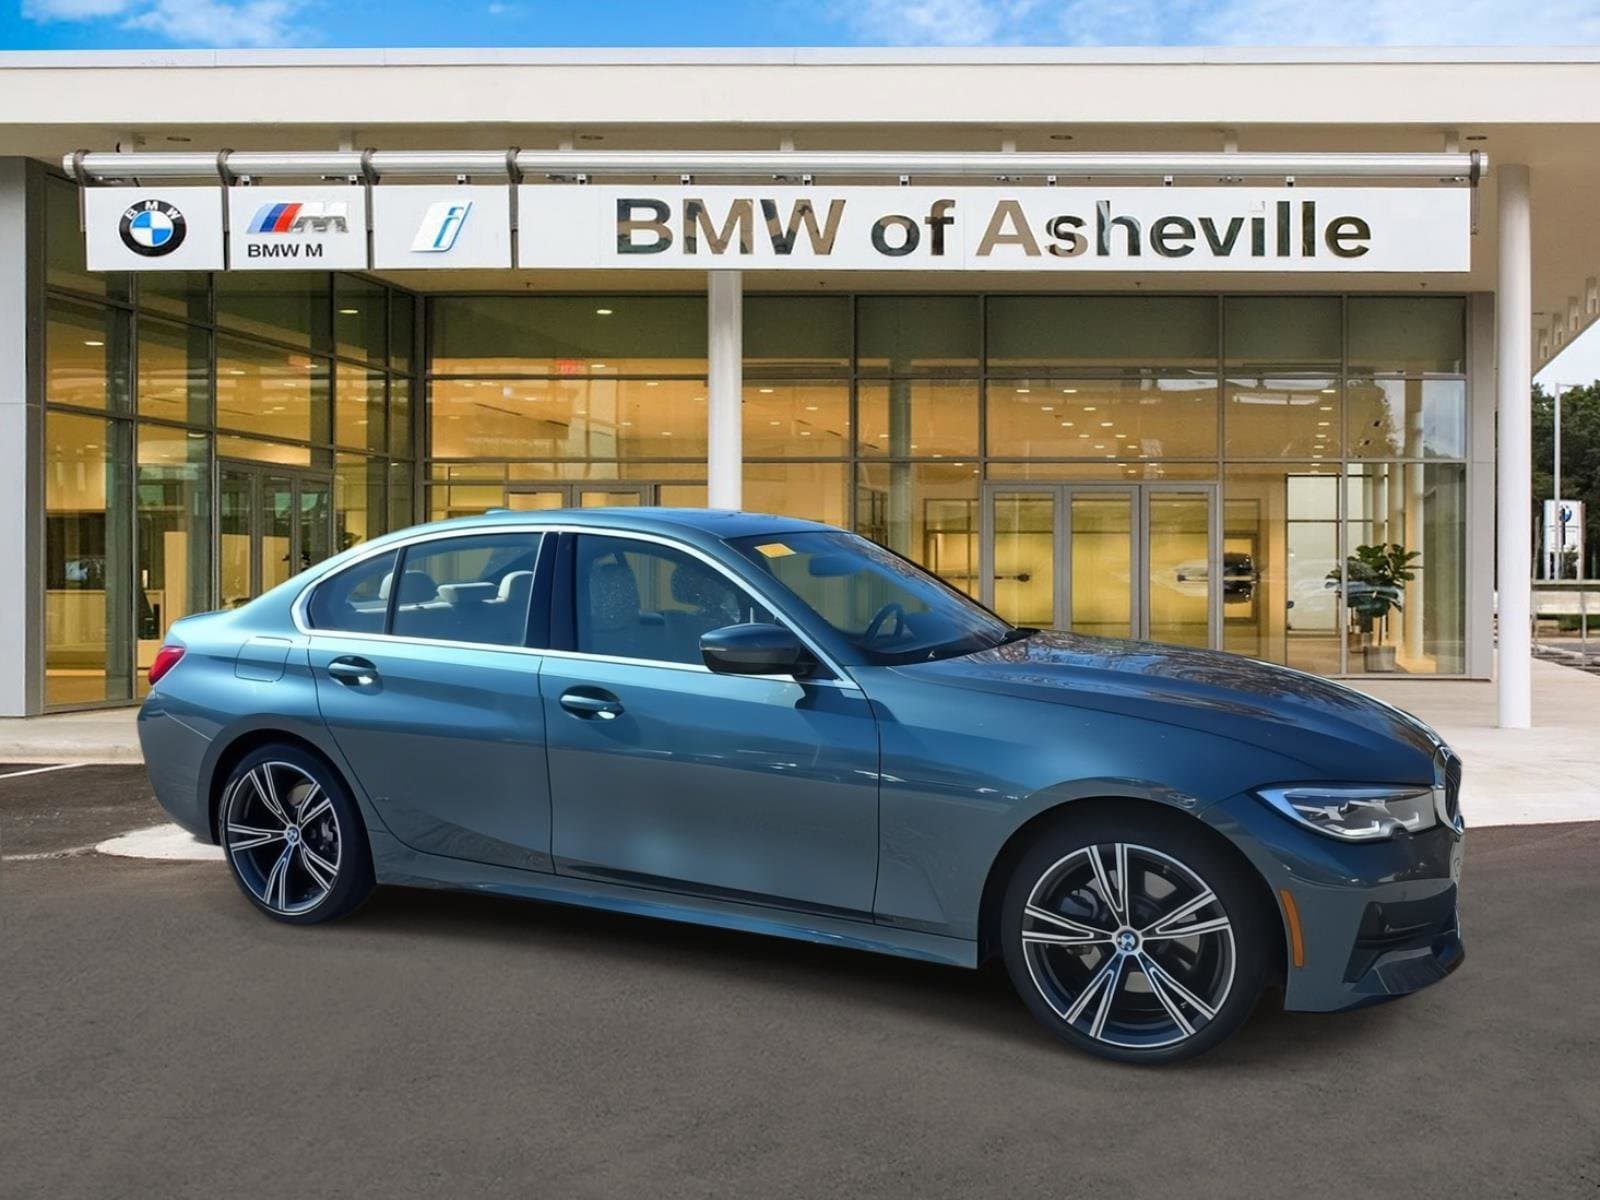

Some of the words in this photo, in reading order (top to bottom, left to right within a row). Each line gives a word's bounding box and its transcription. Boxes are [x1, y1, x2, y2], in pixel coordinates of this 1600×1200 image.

[124, 200, 181, 220] BMW
[616, 198, 846, 255] BMW
[871, 199, 956, 257] of
[976, 199, 1371, 258] Asheville
[247, 243, 299, 258] BMW
[305, 243, 323, 258] M
